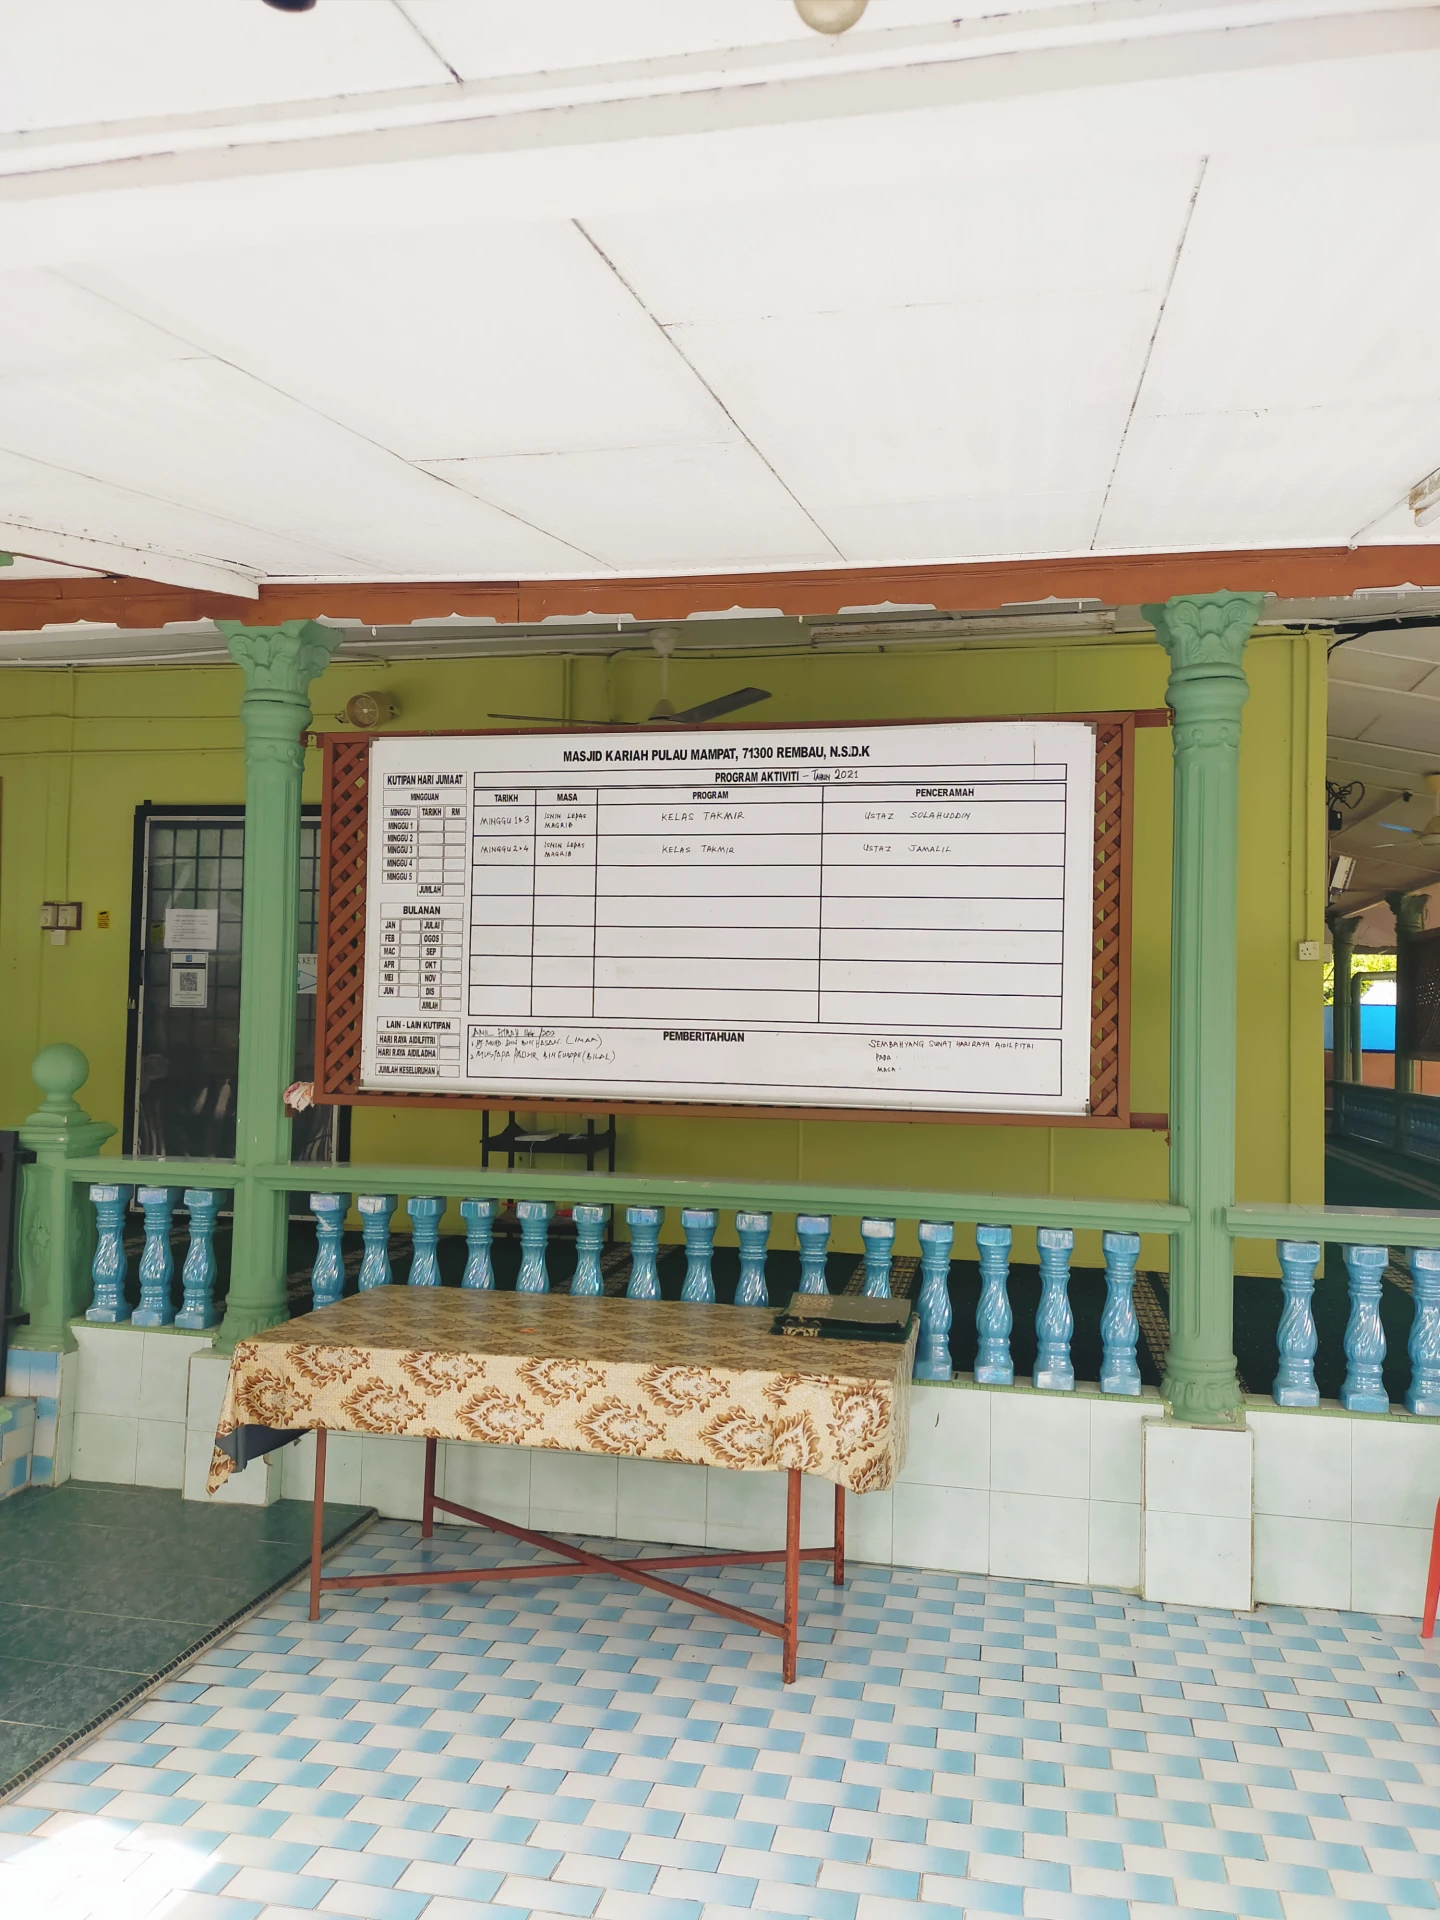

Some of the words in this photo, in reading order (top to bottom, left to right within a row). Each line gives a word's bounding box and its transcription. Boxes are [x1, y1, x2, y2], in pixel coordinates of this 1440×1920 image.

[563, 750, 602, 762] MASJID
[605, 750, 649, 762] KARIAH
[651, 749, 688, 761] PULAU
[690, 748, 739, 762] MAMPAT,
[742, 747, 773, 759] 71300
[776, 746, 826, 760] REMBAU,
[830, 745, 870, 758] N.S.D.K
[715, 772, 758, 783] PROGRAM
[760, 771, 799, 782] AKTIVITI
[834, 769, 859, 780] 2021
[387, 775, 416, 785] KUTIPAN
[417, 775, 434, 785] HARI
[436, 774, 463, 784] JUMAAT
[410, 793, 439, 801] MINGGUAN
[692, 791, 729, 800] PROGRAM
[916, 788, 974, 797] PENCERAMAH
[494, 794, 519, 802] TARIKH
[557, 793, 578, 802] MASA
[390, 808, 411, 816] MINGGU
[422, 808, 442, 816] TARIKH
[451, 808, 460, 816] RM
[661, 812, 694, 822] KELAS
[703, 811, 745, 820] TAKMIR
[864, 811, 894, 820] USTAZ
[910, 811, 971, 820] SOLAHUDDIN
[388, 822, 409, 830] MINGGU
[410, 822, 413, 830] 1
[480, 817, 512, 826] MINGGU
[387, 834, 408, 842] MINGGU
[410, 834, 414, 842] 2
[387, 846, 408, 854] MINGGU
[409, 846, 413, 854] 3
[480, 845, 511, 854] MINGGU
[662, 845, 691, 854] KELAS
[701, 844, 735, 854] TAKMIR
[863, 844, 892, 853] USTAZ
[908, 844, 951, 853] JAMALIL
[419, 886, 441, 894] JUMLAH
[403, 906, 441, 915] BULANAN
[385, 921, 396, 929] JAN
[424, 921, 440, 929] JULAI
[385, 934, 395, 942] FEB
[424, 935, 440, 943] OGOS
[426, 948, 436, 956] SEP
[384, 961, 395, 969] APR
[425, 961, 437, 969] OKT
[384, 974, 394, 982] MEI
[424, 974, 436, 982] NOV
[383, 987, 394, 995] JUN
[422, 1001, 438, 1010] JUMLAH
[386, 1020, 401, 1028] LAIN
[406, 1021, 422, 1029] LAIN
[423, 1021, 451, 1030] KUTIPAN
[379, 1035, 393, 1044] HARI
[394, 1035, 407, 1044] RAYA
[409, 1036, 436, 1044] AIDILFITRI
[663, 1031, 745, 1042] PEMBERITAHUAN
[868, 1040, 924, 1048] SEMBAHYANG
[929, 1040, 952, 1049] SUNAT
[378, 1048, 391, 1056] HARI
[392, 1048, 406, 1057] RAYA
[407, 1049, 436, 1058] AIDILADHA
[378, 1066, 398, 1074] JUMLAH
[399, 1066, 436, 1075] KESELURUHAN
